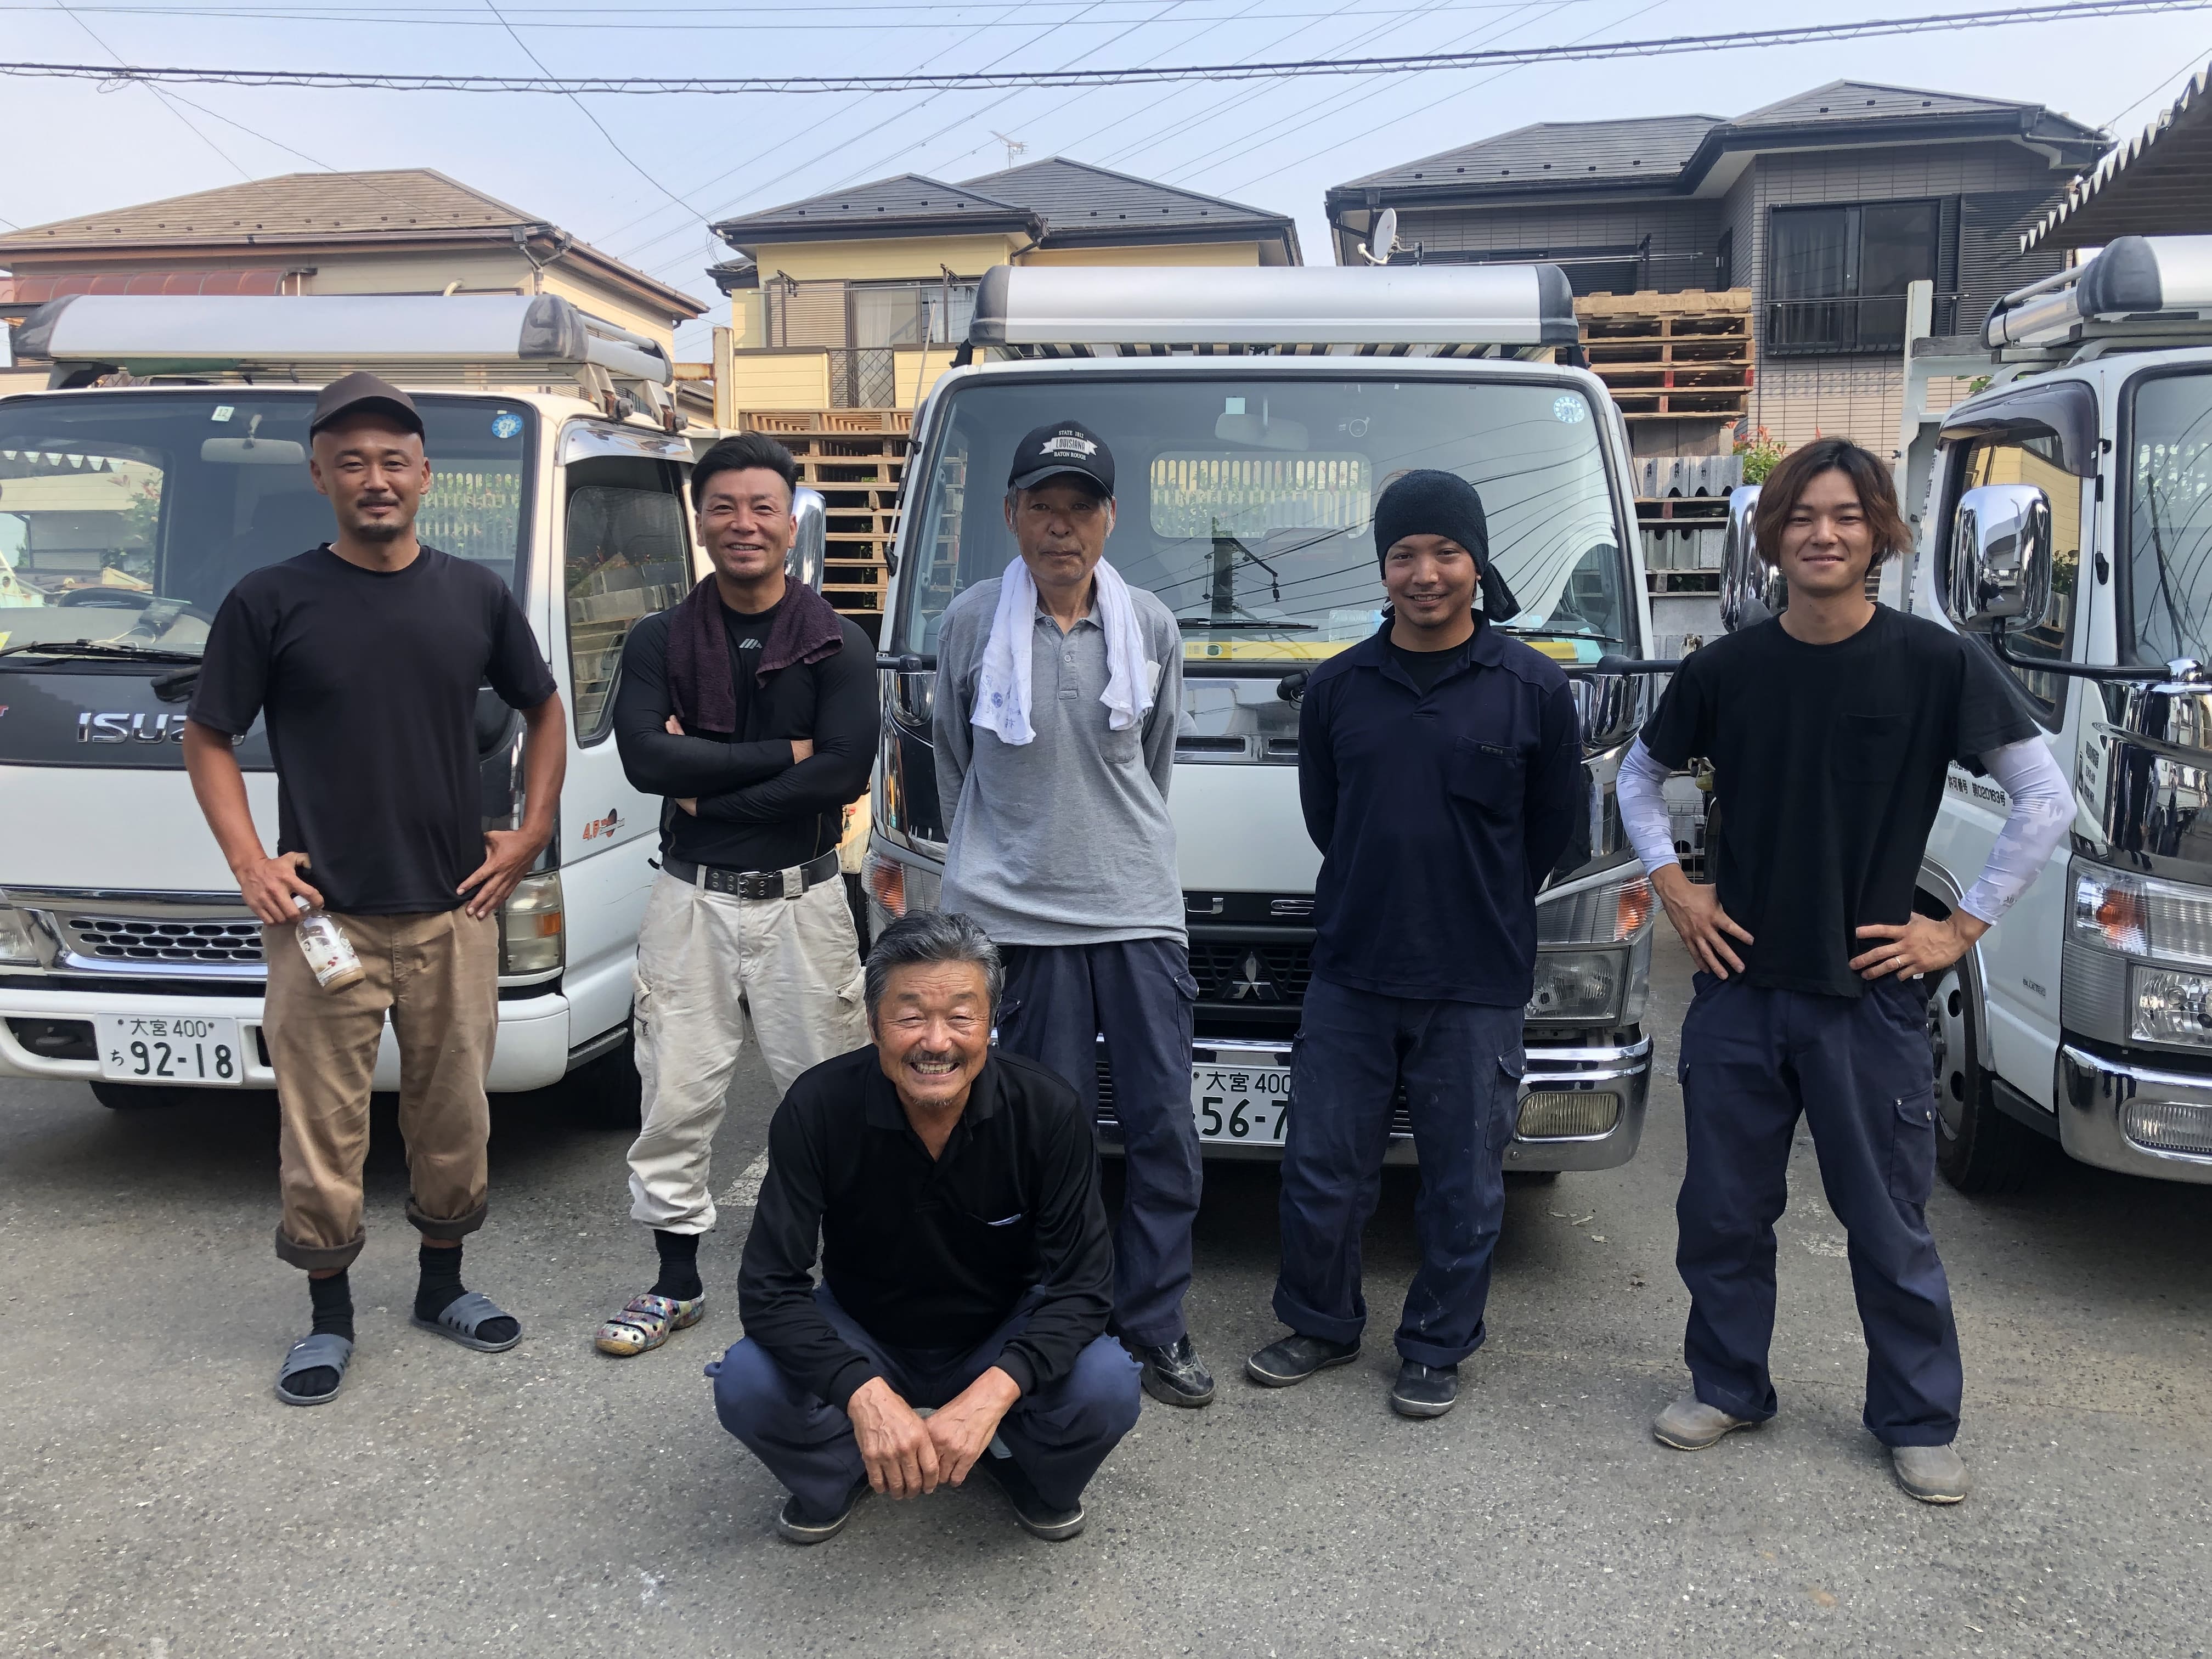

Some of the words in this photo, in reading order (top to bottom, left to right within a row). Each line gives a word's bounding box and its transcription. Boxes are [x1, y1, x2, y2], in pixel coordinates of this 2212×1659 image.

[1564, 407, 1573, 415] 31
[1056, 438, 1085, 451] LOUISIANA
[1070, 452, 1086, 460] ROUGE
[76, 712, 245, 746] ISU
[110, 1049, 125, 1066] ち
[130, 1041, 233, 1079] 92-18
[1201, 1096, 1288, 1139] 56-7
